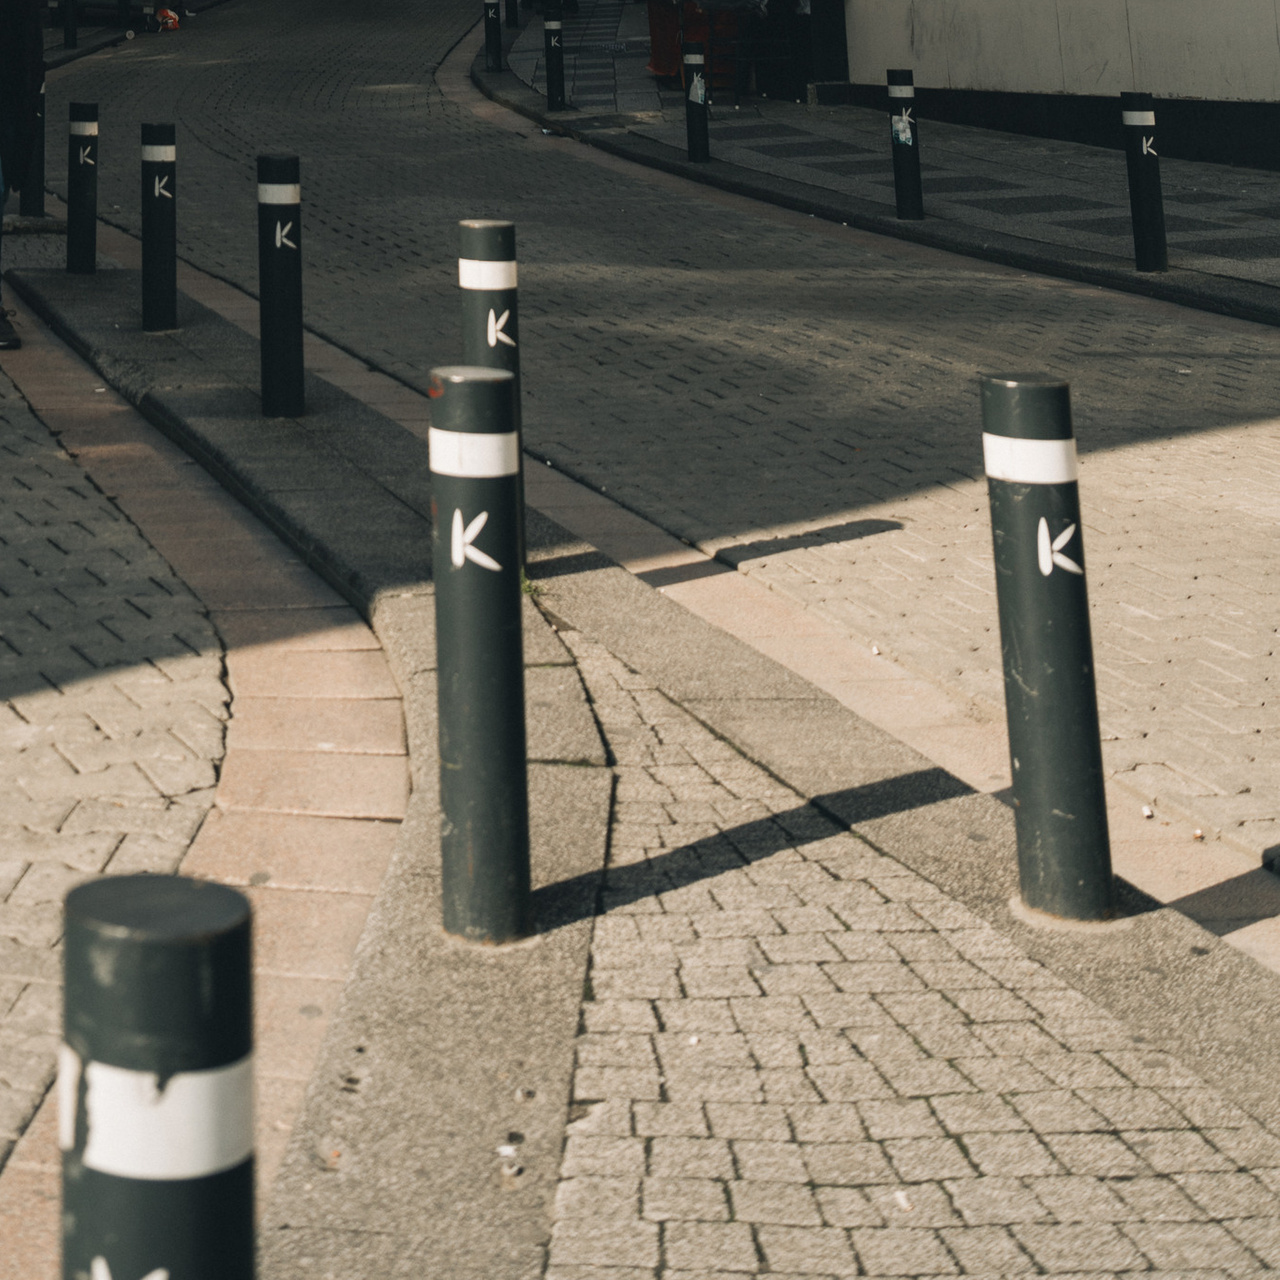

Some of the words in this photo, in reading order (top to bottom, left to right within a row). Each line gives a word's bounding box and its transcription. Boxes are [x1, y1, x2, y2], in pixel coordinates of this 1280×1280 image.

[488, 8, 497, 19] K
[551, 36, 561, 47] K
[79, 145, 95, 165] K
[1142, 136, 1158, 156] K
[154, 175, 173, 199] K
[275, 220, 297, 250] K
[487, 308, 517, 348] K
[451, 508, 503, 572] K
[1037, 516, 1084, 577] K
